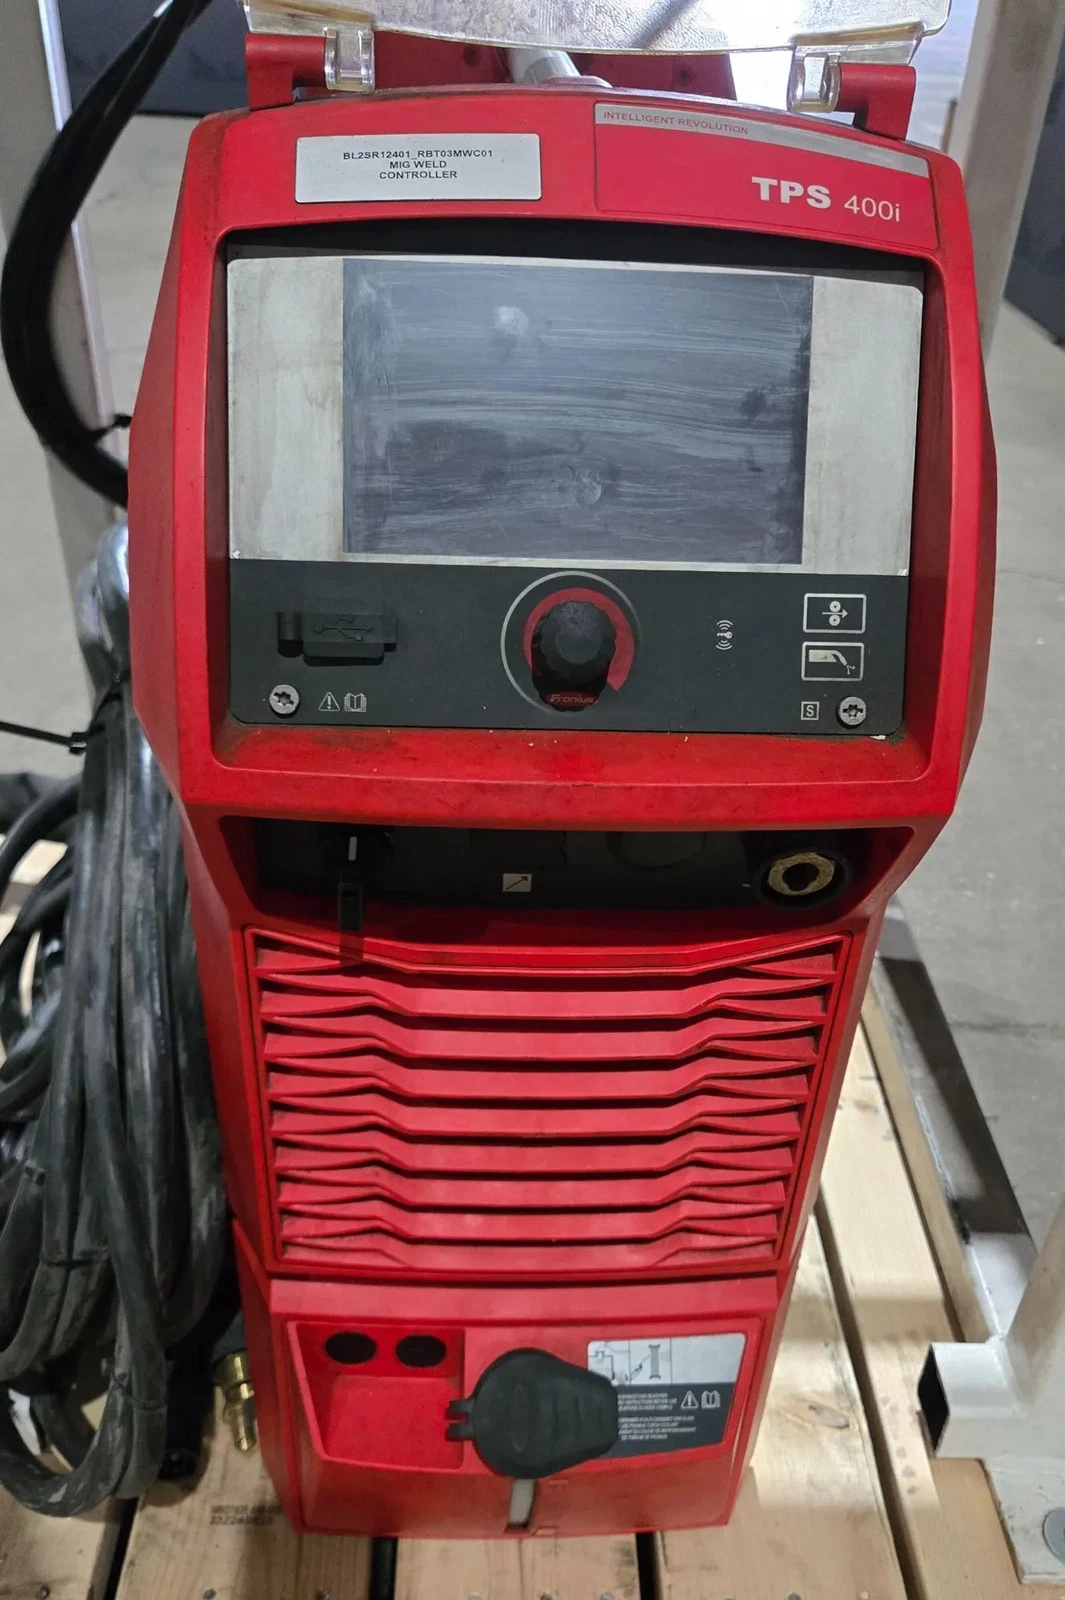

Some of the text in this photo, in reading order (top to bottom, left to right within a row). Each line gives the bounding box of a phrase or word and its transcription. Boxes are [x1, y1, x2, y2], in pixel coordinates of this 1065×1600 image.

[603, 111, 749, 136] INTELLIGENT REVOLUTION
[343, 149, 493, 160] BL2SR12401_RBT03MWC01
[389, 160, 447, 169] MIG WELD
[379, 170, 458, 180] CONTROLLER
[751, 176, 901, 222] TPS 400i
[806, 704, 815, 717] S
